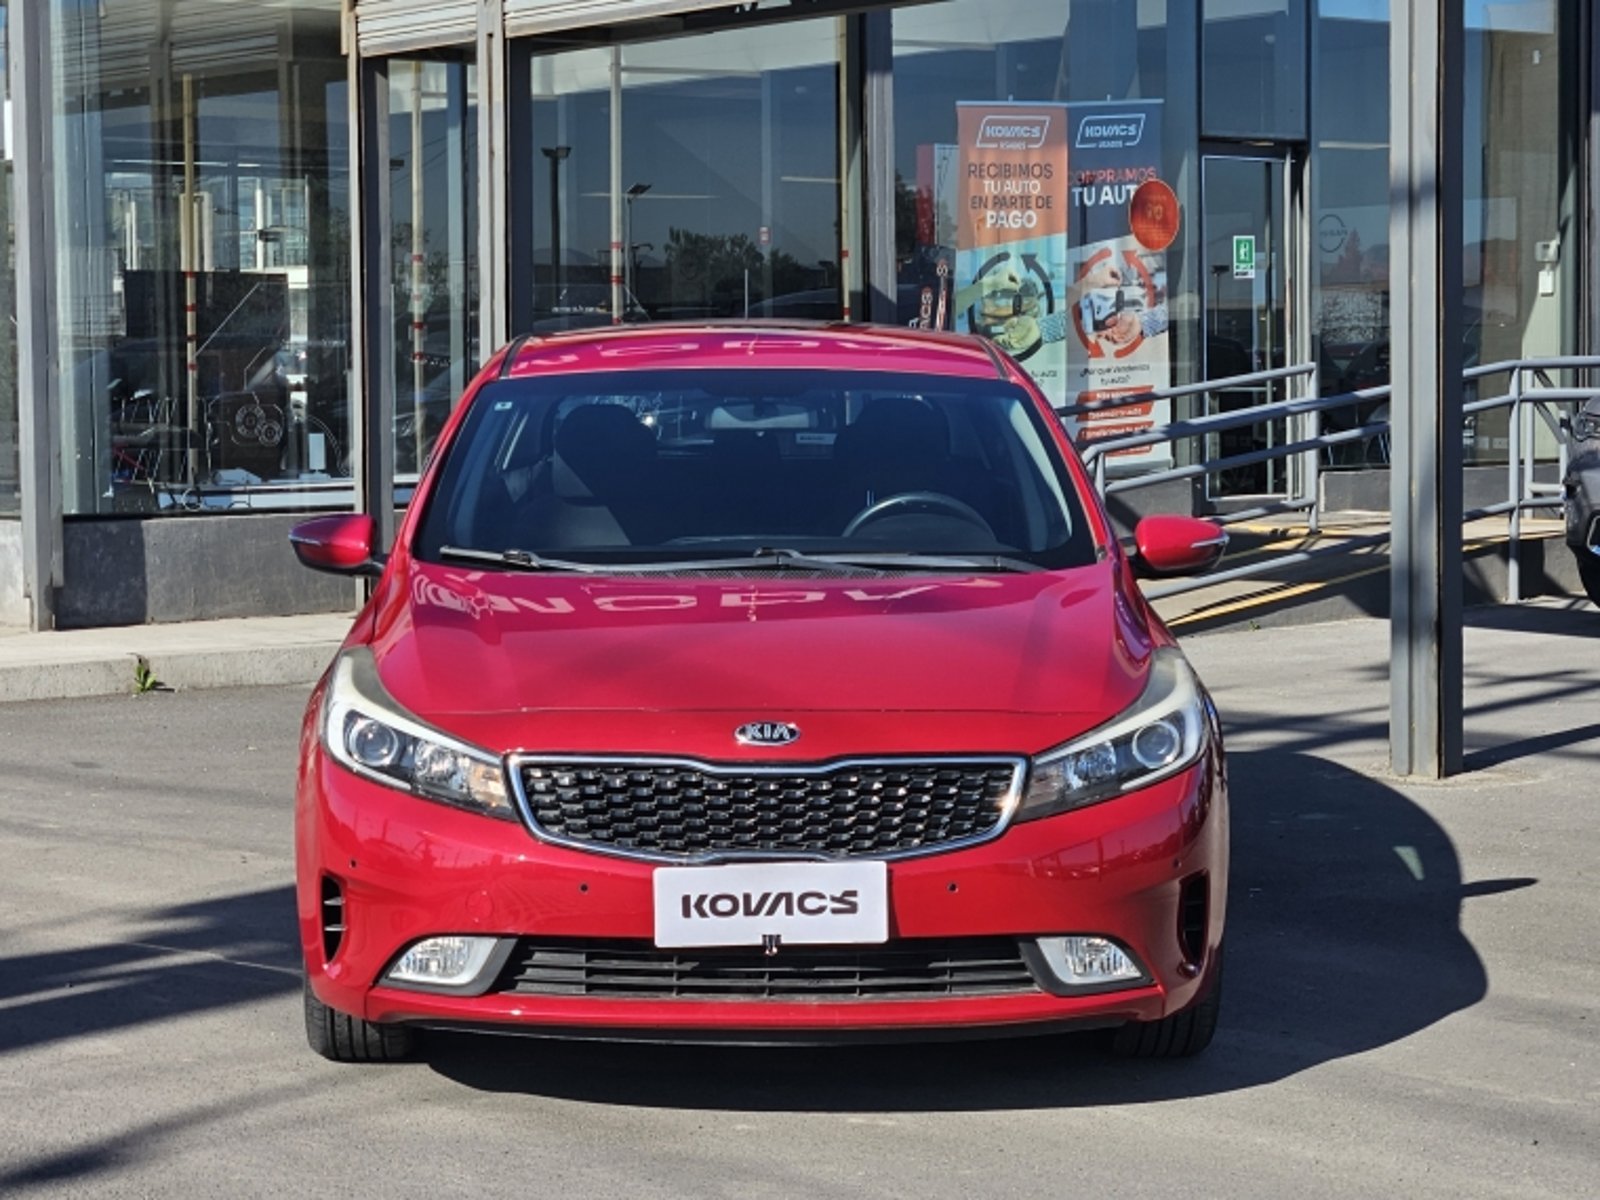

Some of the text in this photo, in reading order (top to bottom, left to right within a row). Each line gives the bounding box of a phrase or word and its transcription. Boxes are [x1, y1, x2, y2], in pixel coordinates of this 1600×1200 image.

[986, 125, 1041, 138] KOVACS
[1084, 124, 1137, 138] KOVACS
[968, 162, 1053, 180] RECIBIMOS
[983, 179, 1041, 194] TU AUTO
[970, 195, 1053, 210] EN PARTE DE
[1071, 183, 1138, 207] TU AUT
[986, 211, 1037, 228] PAGO
[747, 723, 790, 739] KIA
[681, 889, 858, 919] KOVACS
